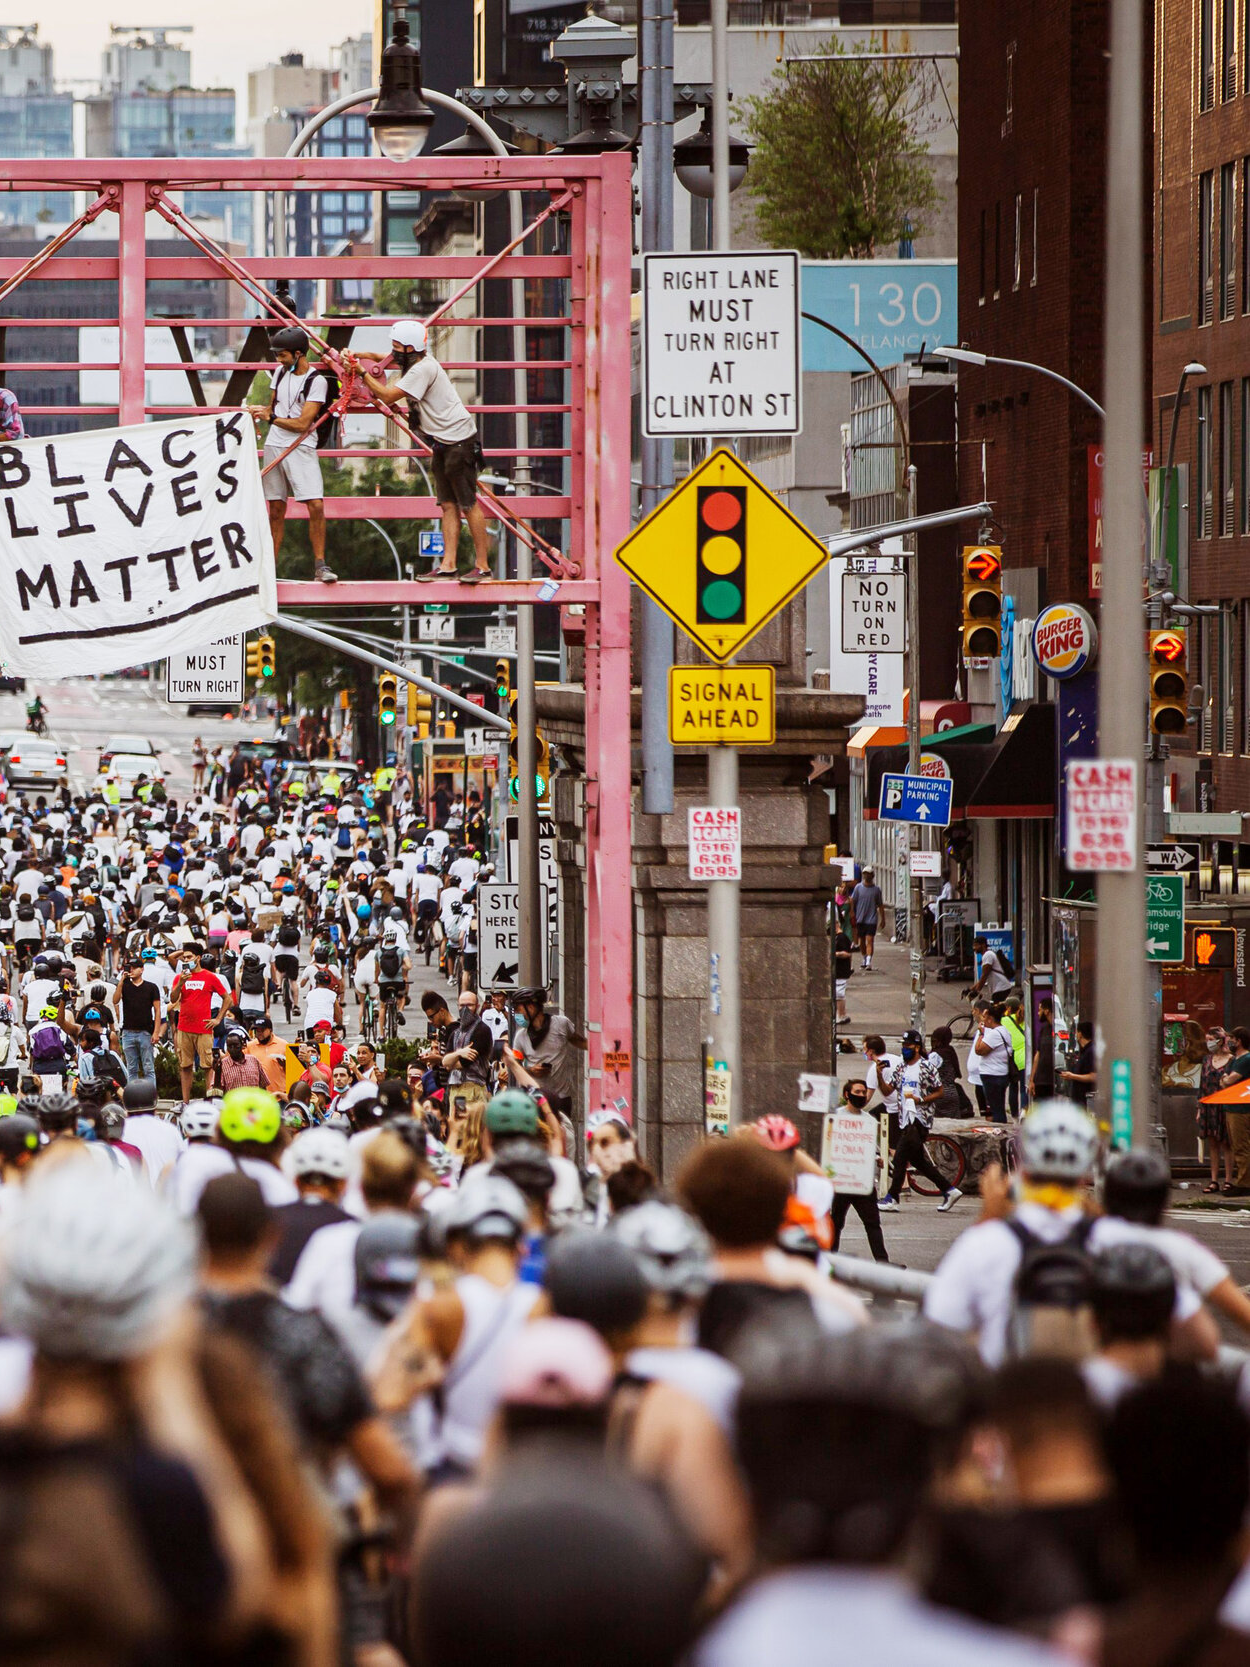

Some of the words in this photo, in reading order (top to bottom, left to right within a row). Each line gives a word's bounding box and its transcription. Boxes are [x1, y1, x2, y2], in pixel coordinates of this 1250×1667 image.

[664, 271, 718, 290] RIGHT
[729, 269, 779, 289] LANE
[690, 299, 753, 322] MUST
[850, 281, 942, 327] 130
[665, 333, 715, 351] TURN
[725, 331, 779, 350] RIGHT
[709, 361, 735, 384] AT
[654, 394, 753, 418] CLINTON
[765, 393, 791, 416] ST
[4, 459, 238, 538] LIVES
[16, 522, 253, 611] MATTER
[860, 581, 889, 596] NO
[852, 601, 896, 613] TURN
[864, 617, 884, 629] ON
[1037, 617, 1082, 644] BURGER
[211, 633, 239, 645] ANE
[857, 634, 890, 645] RED
[1039, 630, 1084, 664] KING
[187, 656, 226, 670] MUST
[172, 681, 201, 692] TURN
[207, 681, 239, 692] RIGHT
[868, 667, 877, 695] CARE
[680, 683, 763, 701] SIGNAL
[865, 704, 891, 712] angone
[682, 709, 759, 728] AHEAD
[921, 760, 944, 773] RGER
[908, 780, 949, 793] MUNICIPAL
[906, 790, 940, 801] PARKING
[693, 810, 738, 826] CA$H
[540, 822, 557, 835] NY
[696, 843, 735, 853] (516)
[699, 854, 732, 864] 636
[1161, 853, 1186, 863] WAY
[694, 866, 738, 877] 9595
[490, 894, 518, 910] ST
[1146, 909, 1181, 919] amsburg
[486, 917, 516, 926] HERE
[1146, 922, 1170, 932] ridge
[495, 933, 519, 949] RE
[1237, 928, 1247, 987] Newsstand
